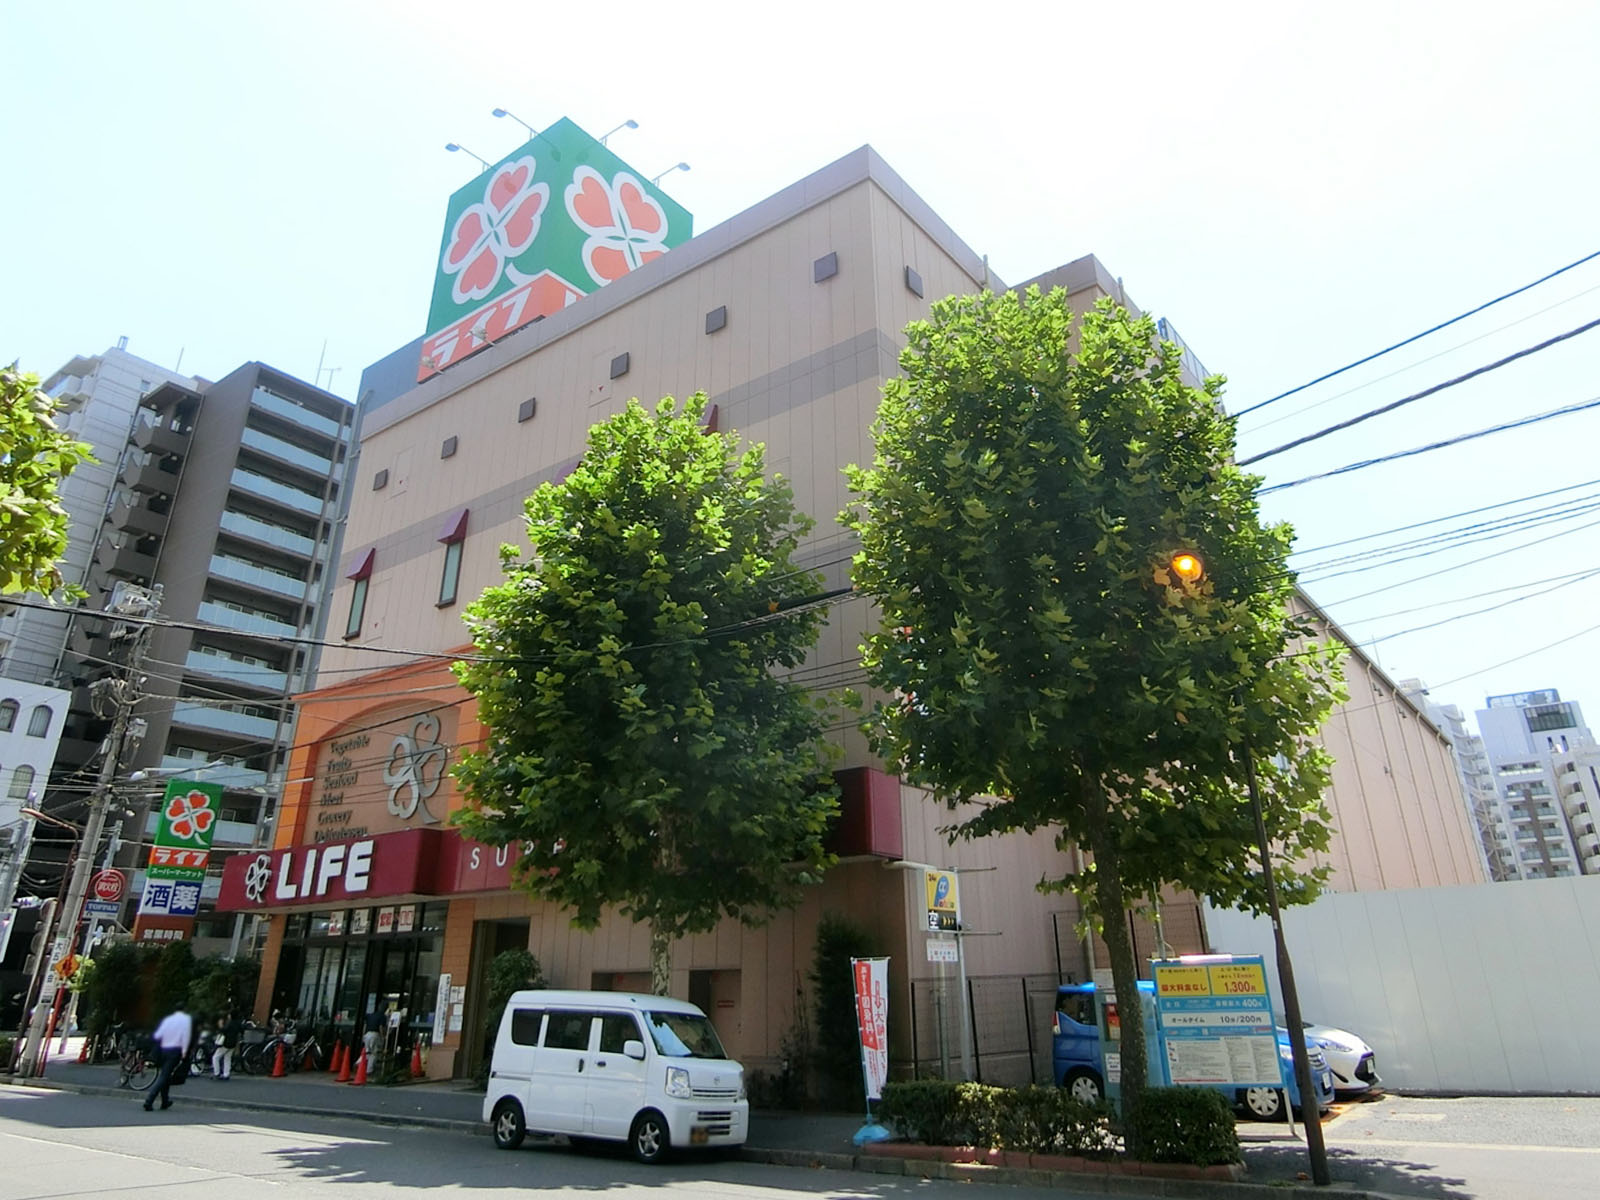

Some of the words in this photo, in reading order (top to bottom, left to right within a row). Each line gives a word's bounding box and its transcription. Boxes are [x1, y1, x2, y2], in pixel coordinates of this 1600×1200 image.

[331, 734, 370, 756] Vegetable
[323, 771, 358, 790] Seafood
[320, 792, 344, 806] Meat
[318, 810, 353, 825] Grocery
[155, 849, 207, 866] ライフ
[151, 868, 203, 878] スーパーマーケット
[275, 840, 375, 900] LIFE
[145, 884, 172, 908] 酒
[171, 885, 200, 910] 薬
[87, 903, 119, 912] TOPPAN
[1224, 980, 1257, 993] 1,300円
